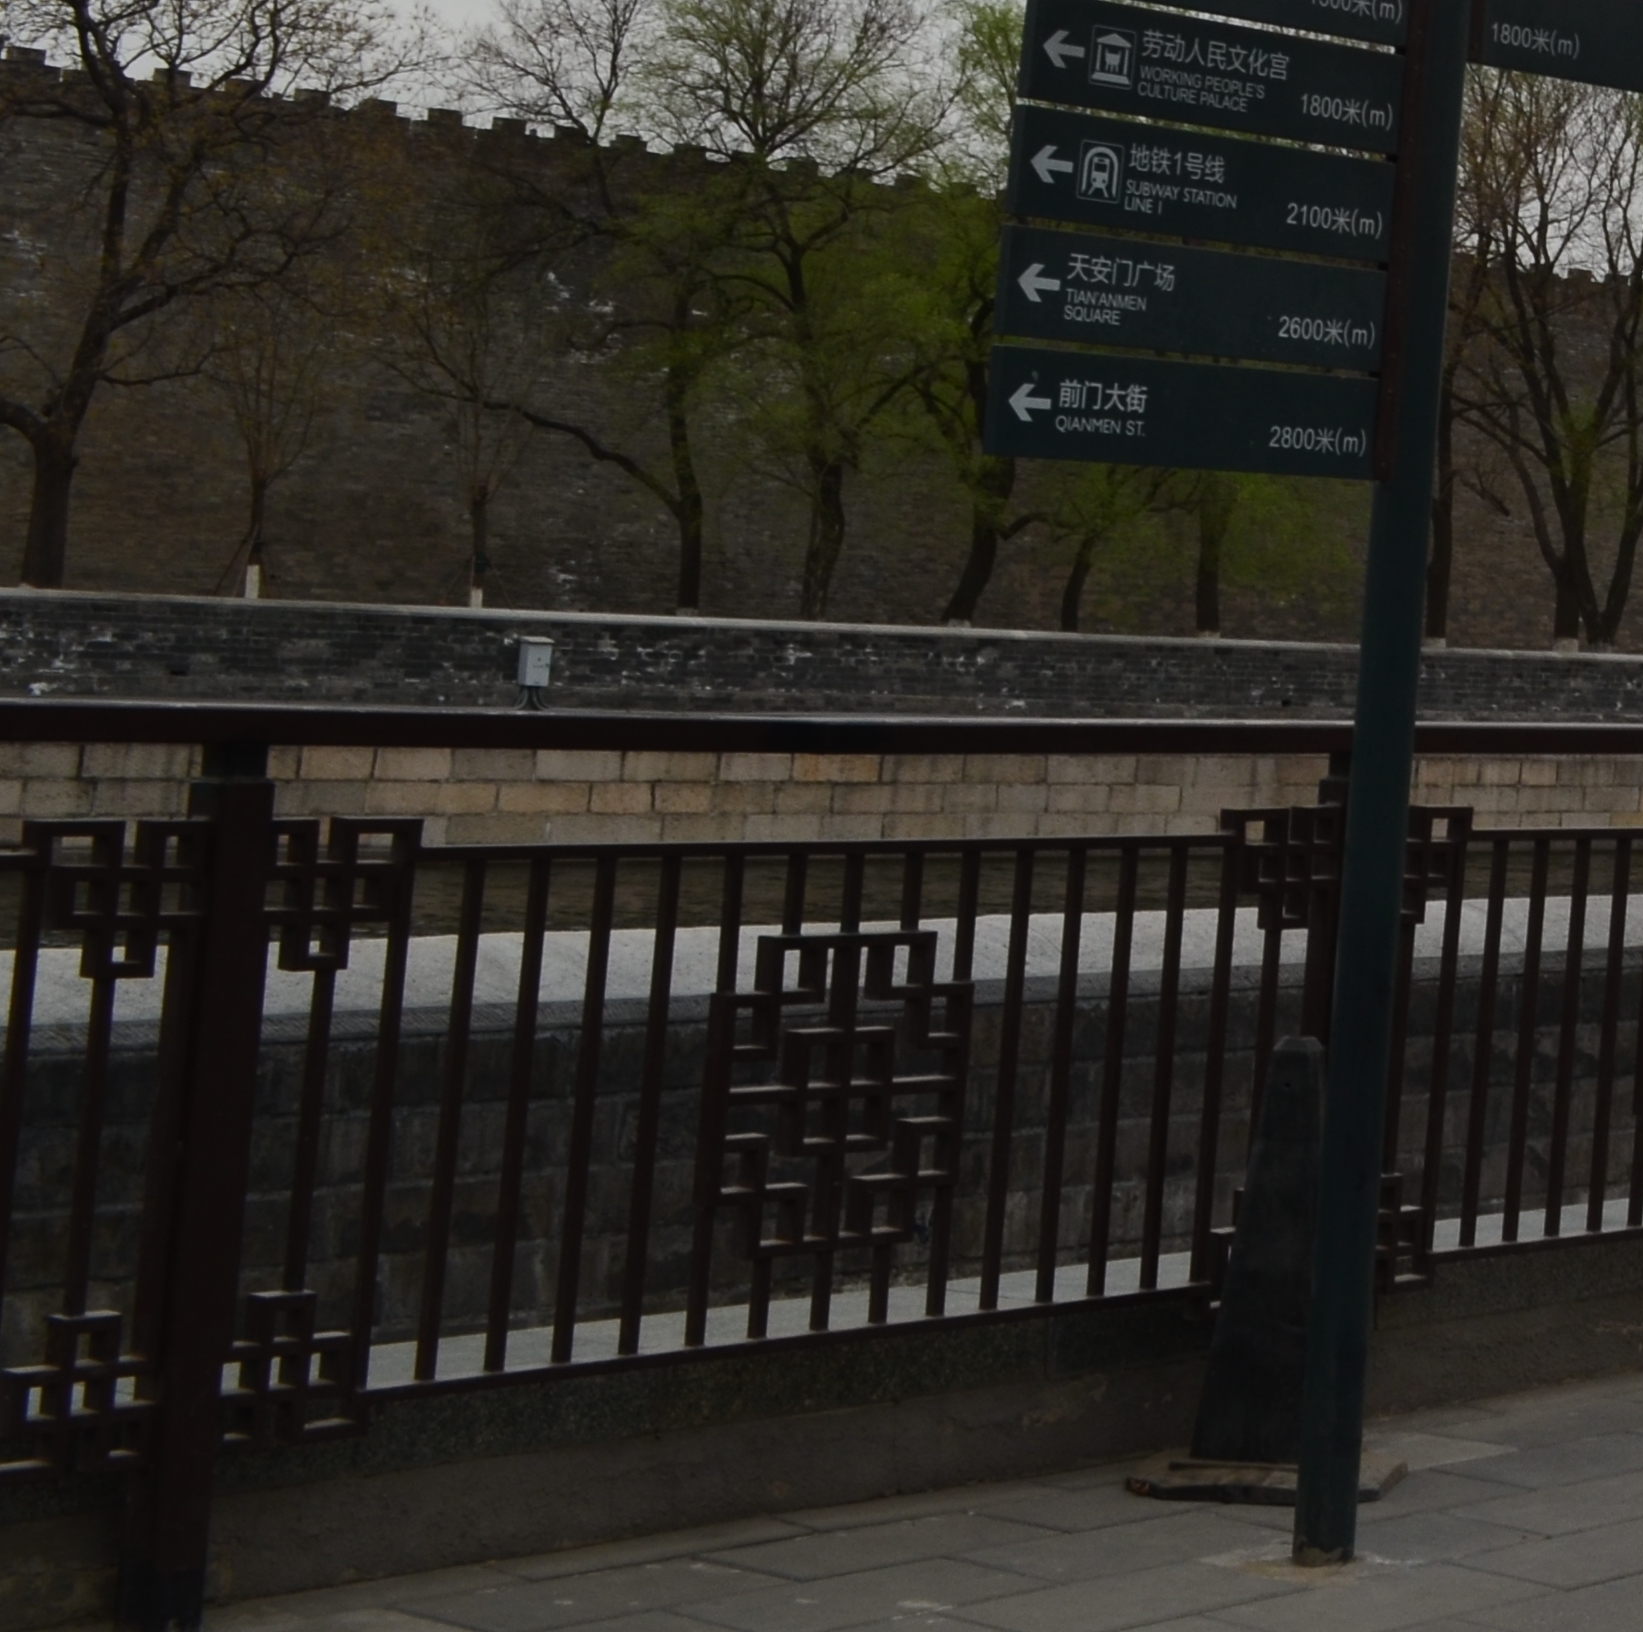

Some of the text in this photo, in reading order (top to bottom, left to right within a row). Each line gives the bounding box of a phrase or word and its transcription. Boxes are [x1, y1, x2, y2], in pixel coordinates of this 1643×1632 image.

[1142, 28, 1290, 81] 劳动人民文化宫
[1139, 65, 1201, 88] WORKING
[1137, 81, 1248, 113] CULTURE PALACE
[1129, 142, 1225, 184] 地铁1号线
[1124, 196, 1153, 214] LINE
[1125, 179, 1237, 209] SUBWAY STATION
[1066, 252, 1175, 292] 天安门广场
[1063, 305, 1121, 326] SQUARE
[1058, 378, 1148, 414] 前门大街
[1055, 415, 1146, 437] QIANMEN ST.
